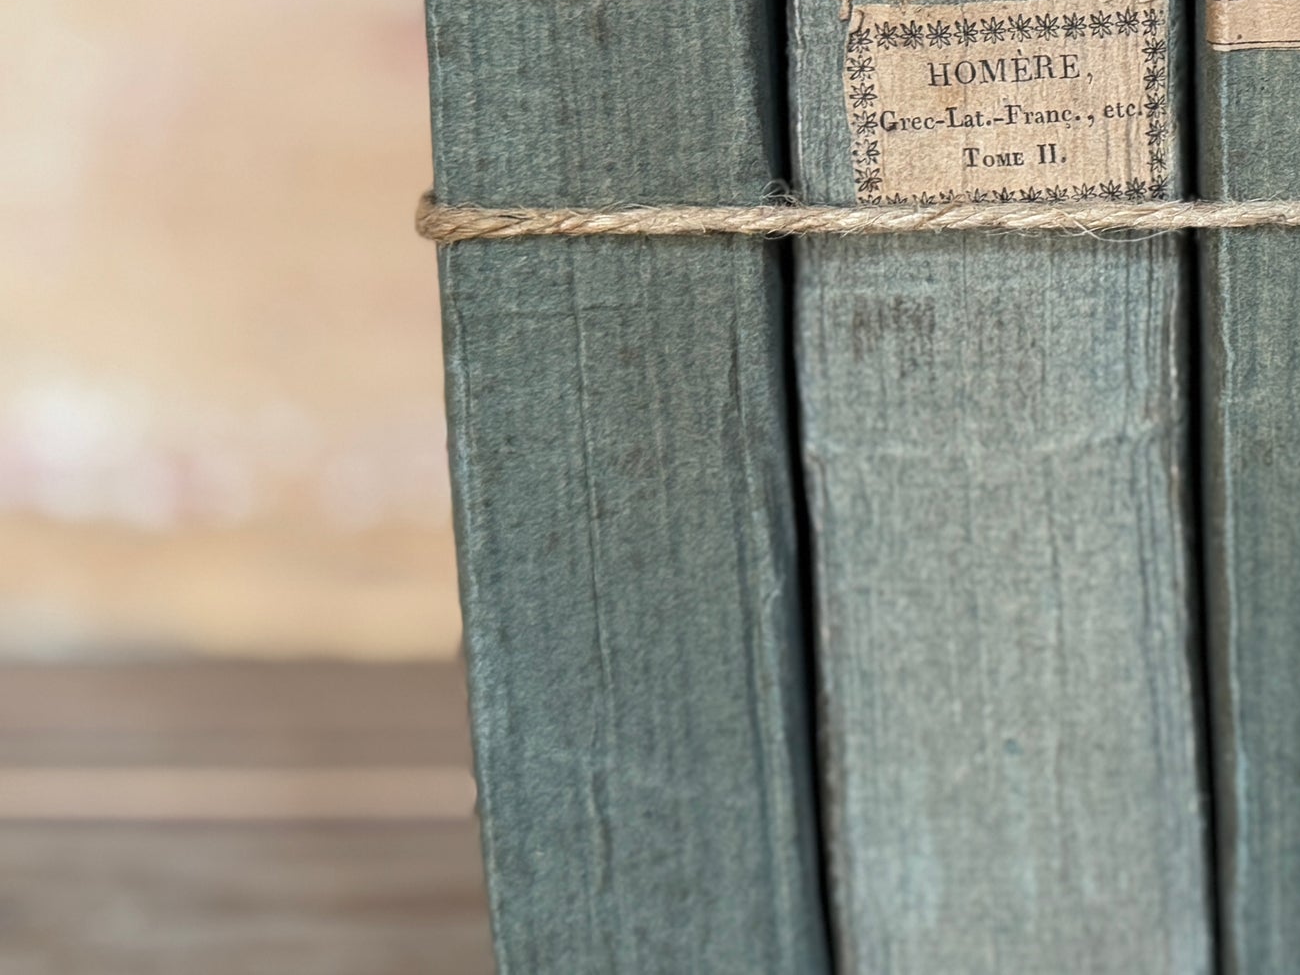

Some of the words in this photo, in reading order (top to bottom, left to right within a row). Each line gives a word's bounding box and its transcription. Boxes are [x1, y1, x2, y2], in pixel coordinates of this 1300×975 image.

[927, 49, 1094, 88] HOMÈRE,
[1103, 99, 1143, 120] etc.
[963, 146, 1025, 168] TOME
[1037, 143, 1067, 165] II.
